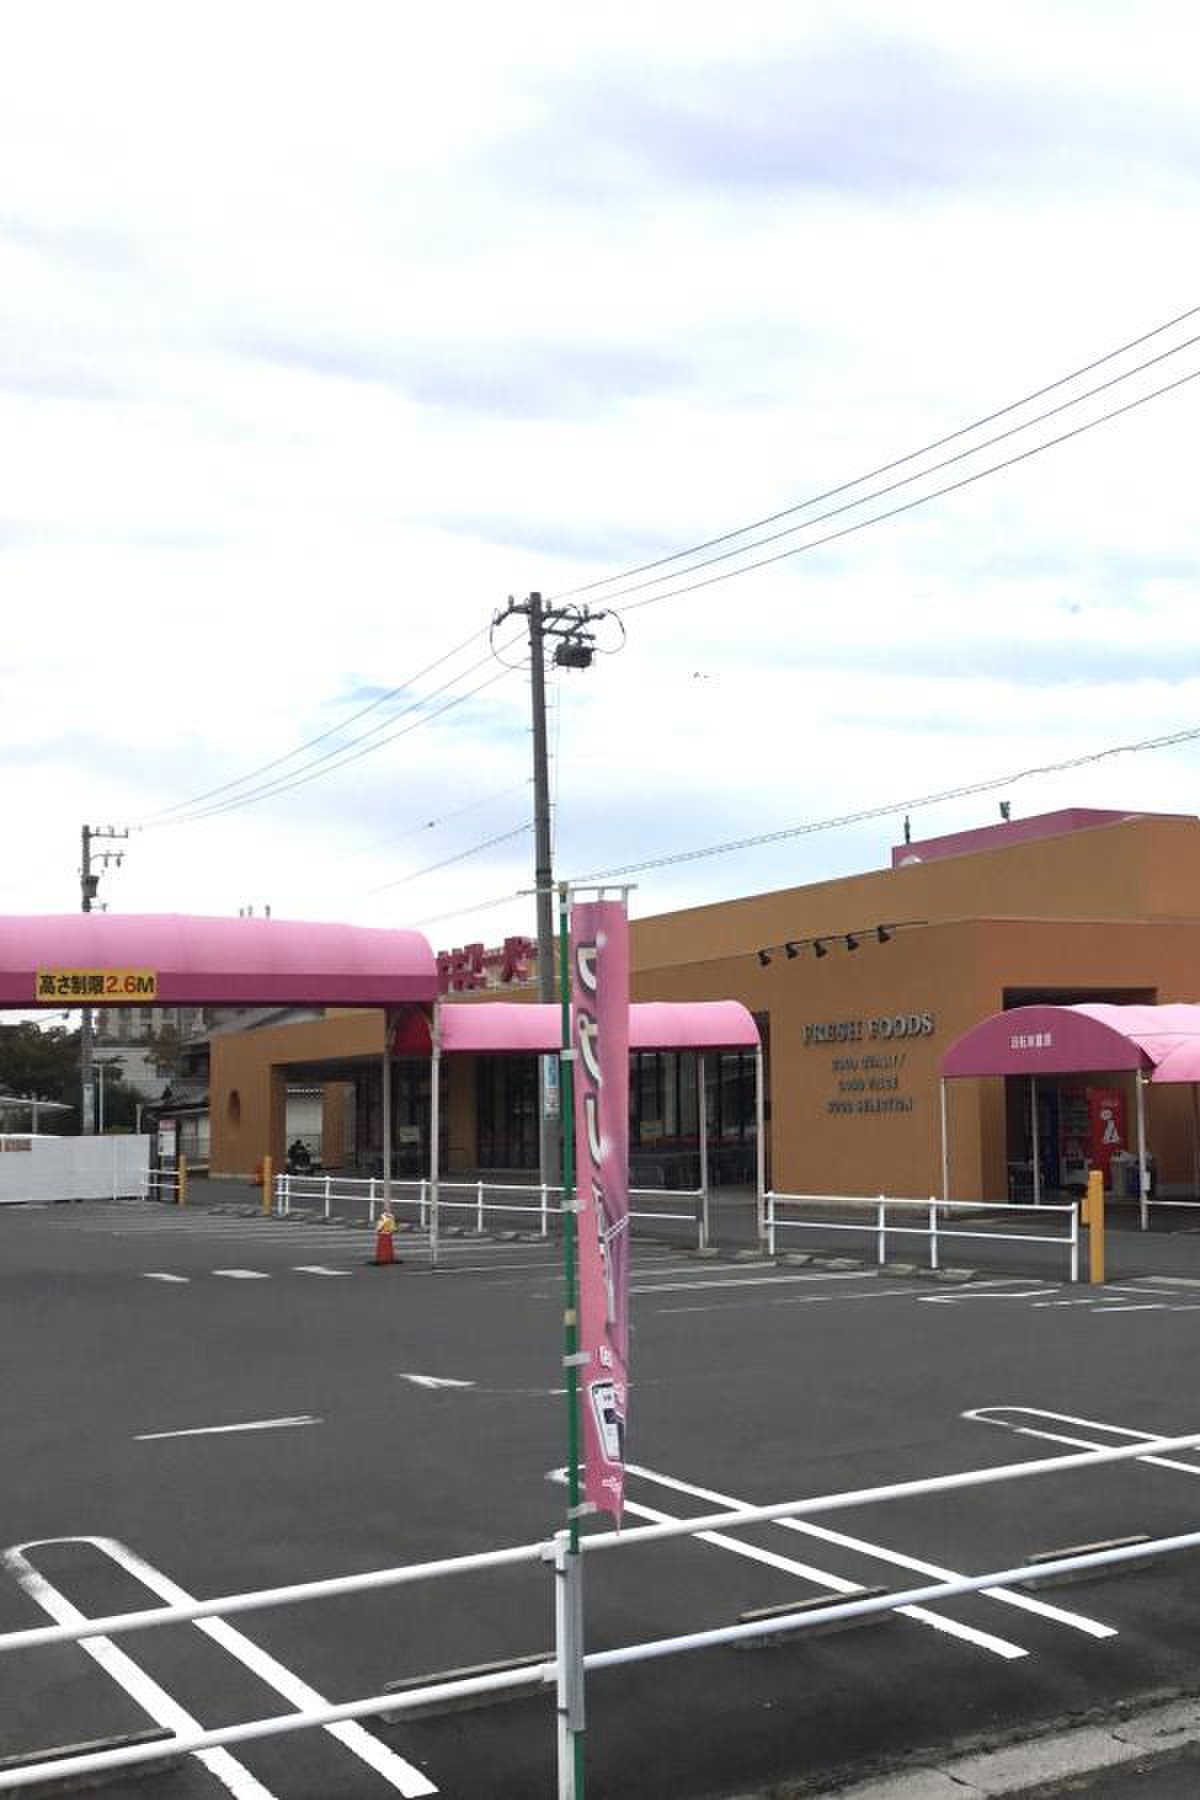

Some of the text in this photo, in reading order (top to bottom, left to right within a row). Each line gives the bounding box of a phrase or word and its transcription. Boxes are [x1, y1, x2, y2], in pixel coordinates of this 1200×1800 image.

[38, 974, 155, 995] 高さ制限2.6M
[866, 1013, 935, 1040] FOODS
